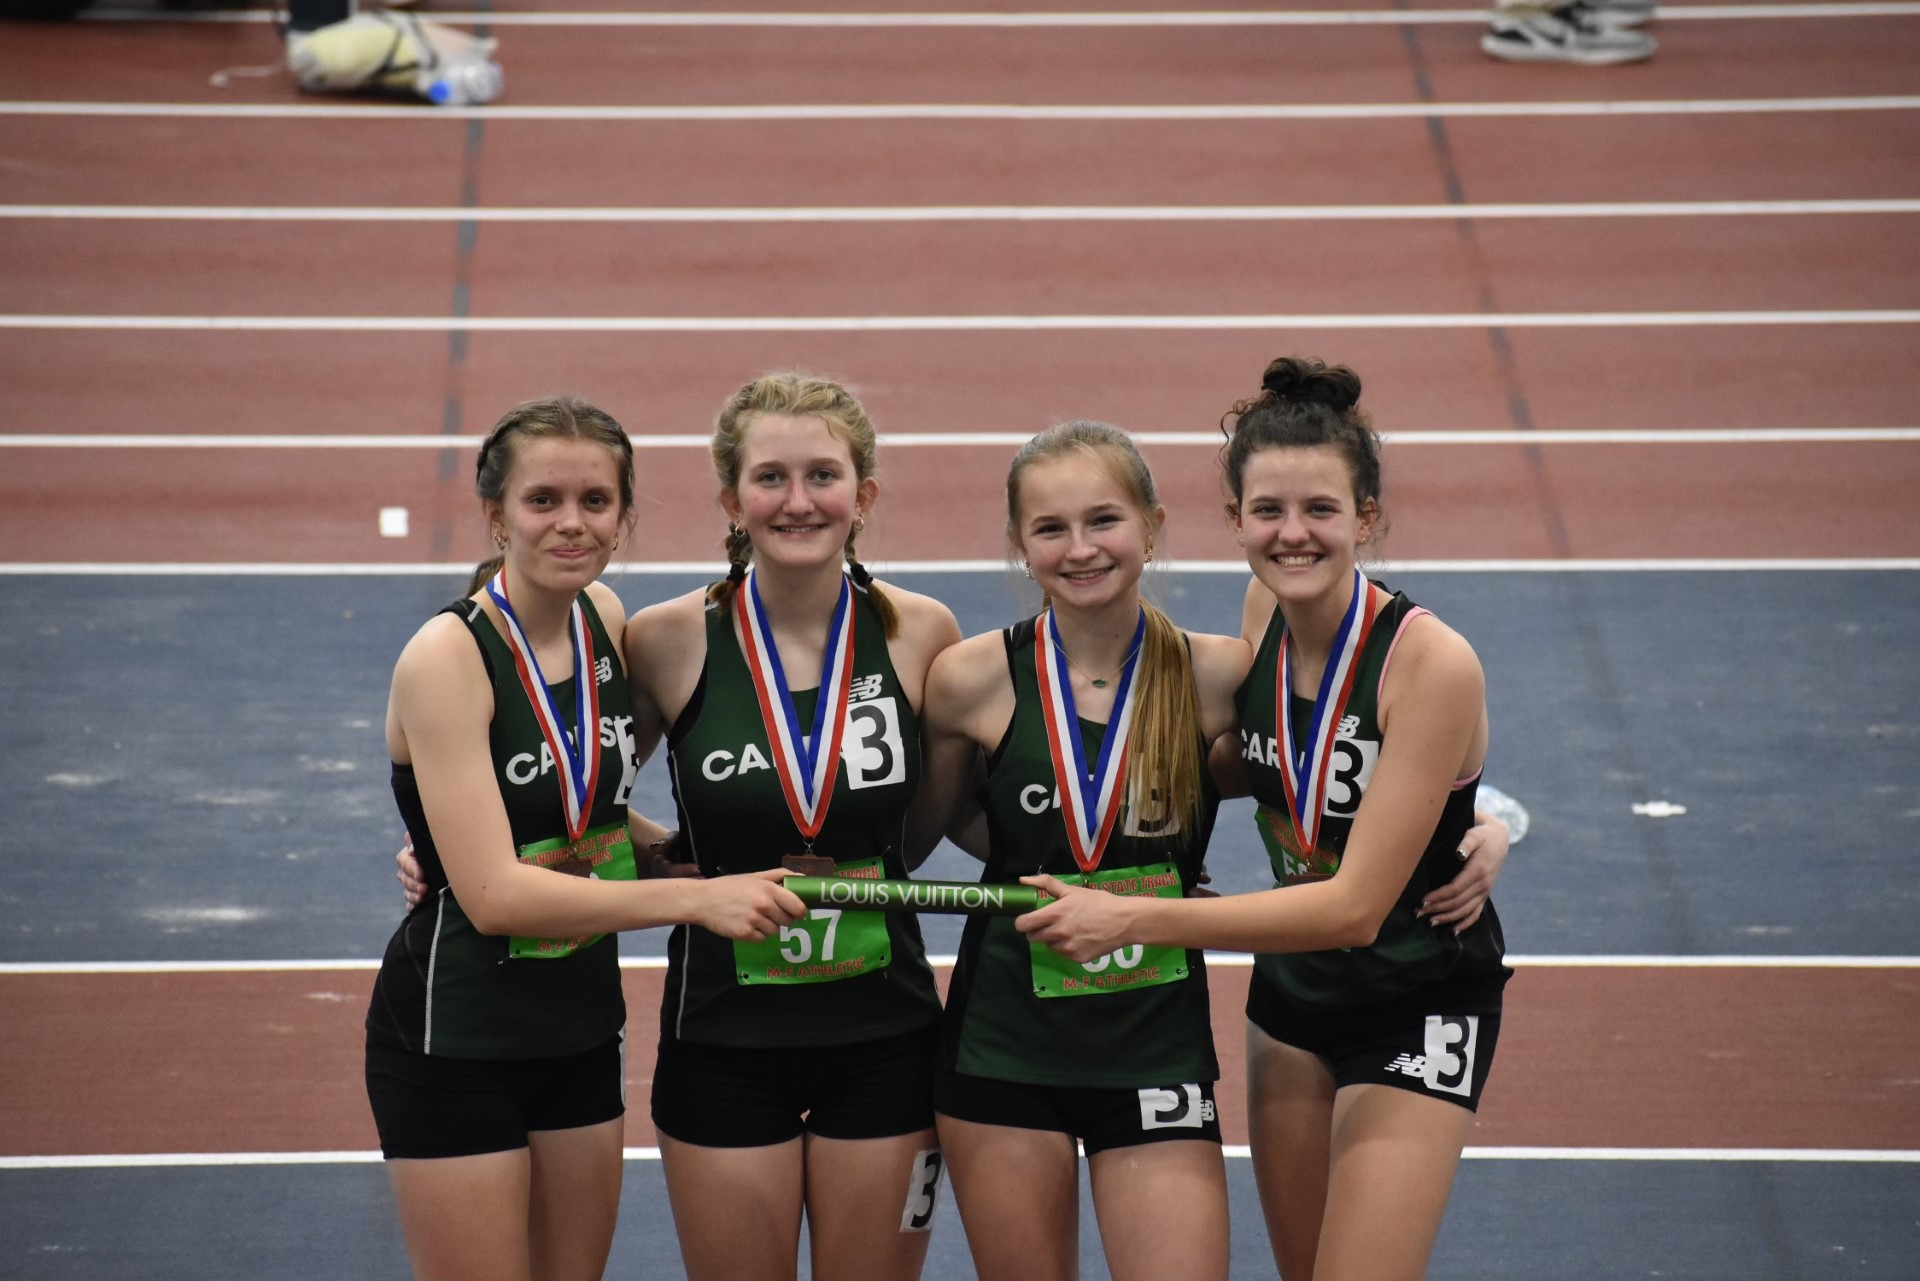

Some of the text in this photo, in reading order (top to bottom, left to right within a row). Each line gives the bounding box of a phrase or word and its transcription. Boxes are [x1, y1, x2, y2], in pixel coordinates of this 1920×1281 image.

[850, 705, 893, 782] 3
[1328, 740, 1363, 814] 3
[820, 882, 1004, 908] LOUIS VUITTON
[1141, 873, 1177, 890] TRACK
[780, 909, 842, 964] 57
[797, 957, 865, 978] ATHLETIC
[1064, 966, 1161, 990] M-F ATHLETIC
[1436, 1015, 1470, 1088] 3
[911, 1152, 941, 1228] 3
